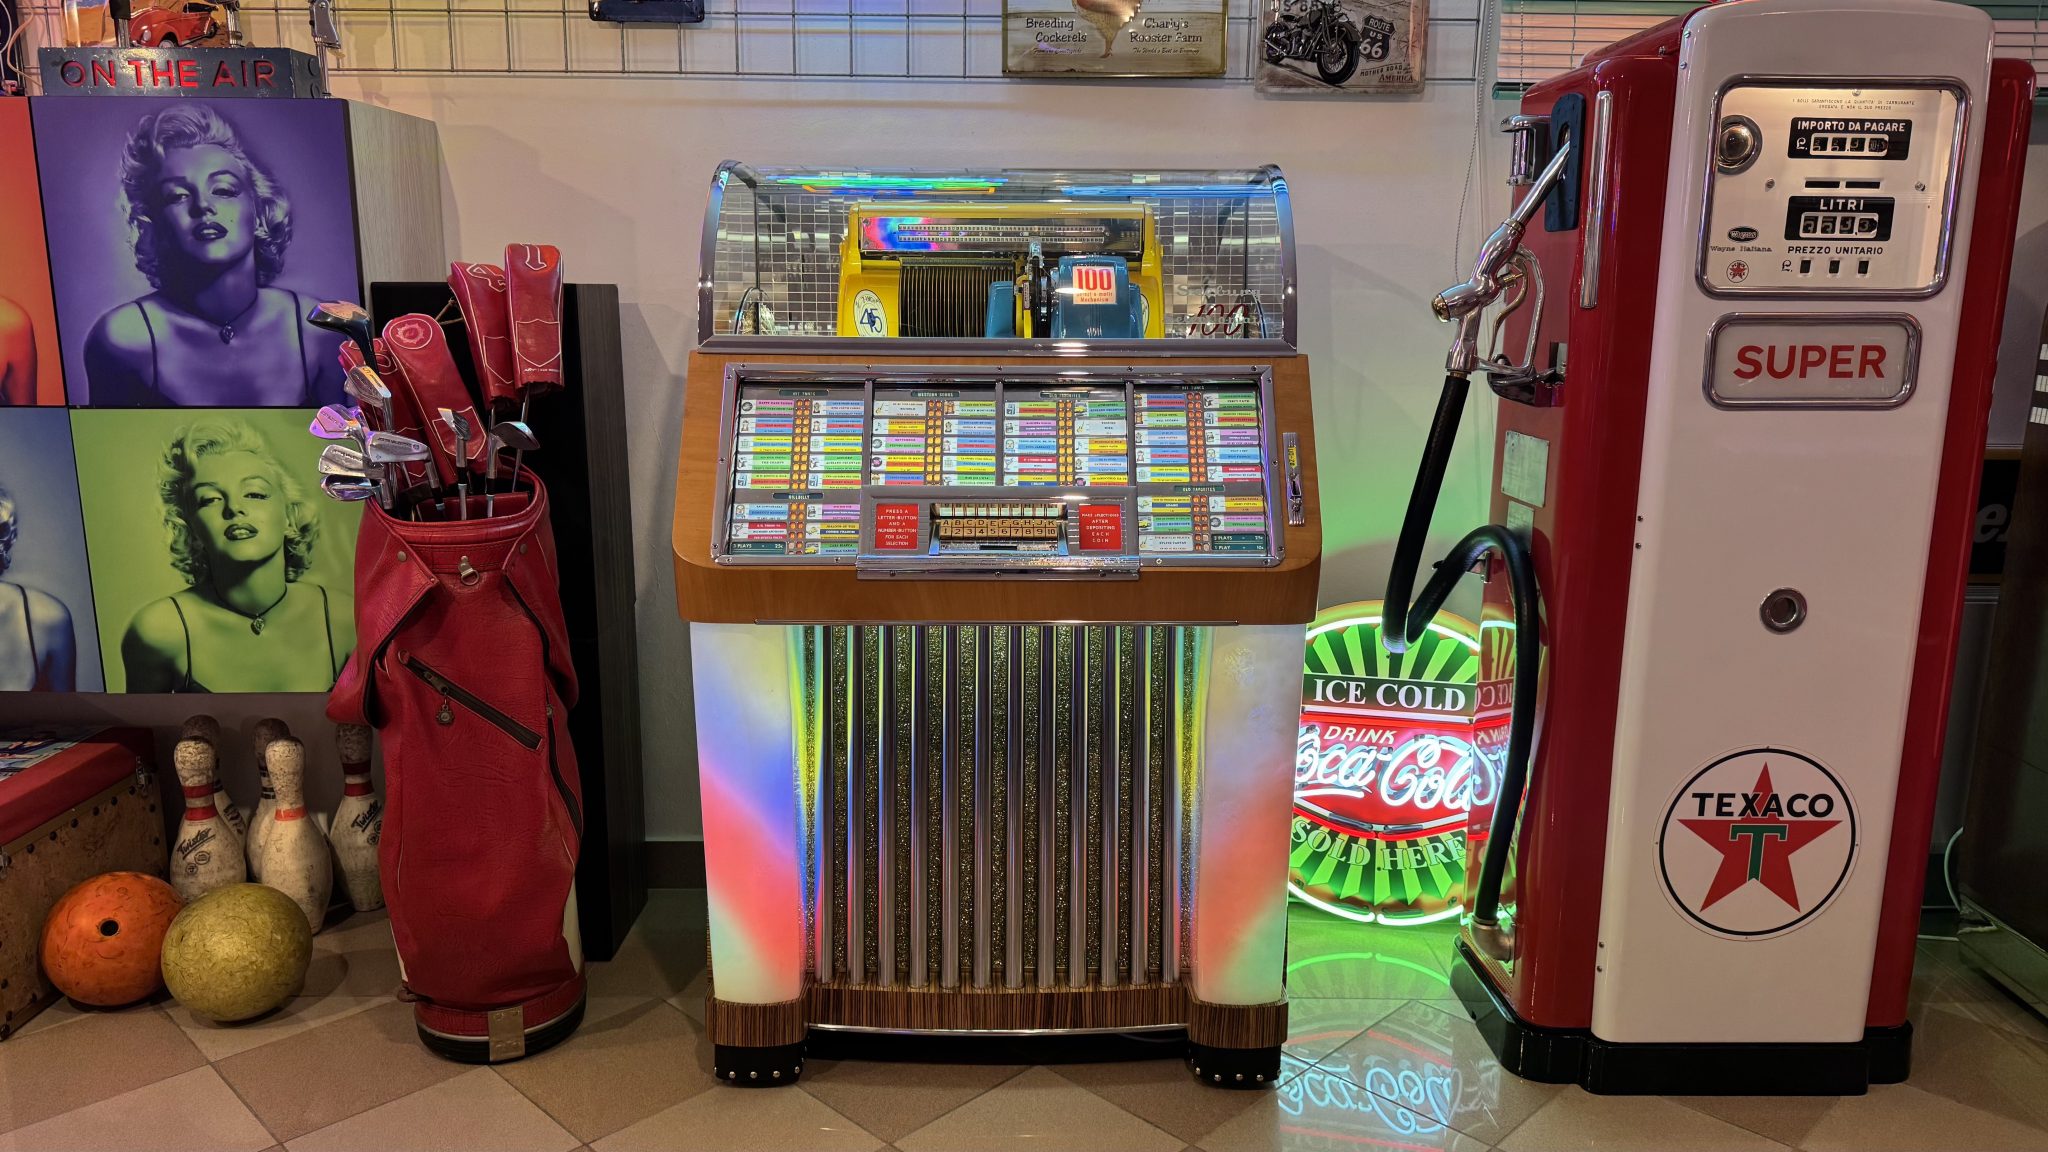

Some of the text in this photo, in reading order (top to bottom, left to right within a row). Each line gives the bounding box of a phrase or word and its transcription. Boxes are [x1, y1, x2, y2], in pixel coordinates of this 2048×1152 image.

[1026, 18, 1074, 30] Breeding
[1369, 17, 1391, 32] ROUTE
[1036, 32, 1087, 43] Cockerels
[1130, 32, 1202, 43] Rooster Farm
[1360, 39, 1383, 58] 66
[61, 60, 278, 88] ON THE AIR
[1379, 74, 1413, 82] AMERICA
[1797, 121, 1906, 132] IMPORTO DA PAGARE
[1819, 198, 1864, 211] LITRI
[1787, 246, 1883, 255] PREZZO UNITARIO
[1076, 269, 1112, 290] 100
[859, 308, 882, 333] 45
[1188, 304, 1249, 335] 100
[1733, 344, 1886, 379] SUPER
[1314, 679, 1366, 704] ICE
[1376, 683, 1466, 711] COLD
[1323, 725, 1398, 745] DRINK
[351, 799, 382, 829] Twister
[1692, 793, 1834, 818] TEXACO
[177, 827, 214, 856] Twister
[1291, 819, 1467, 871] SOLD HERE
[1728, 824, 1789, 882] T
